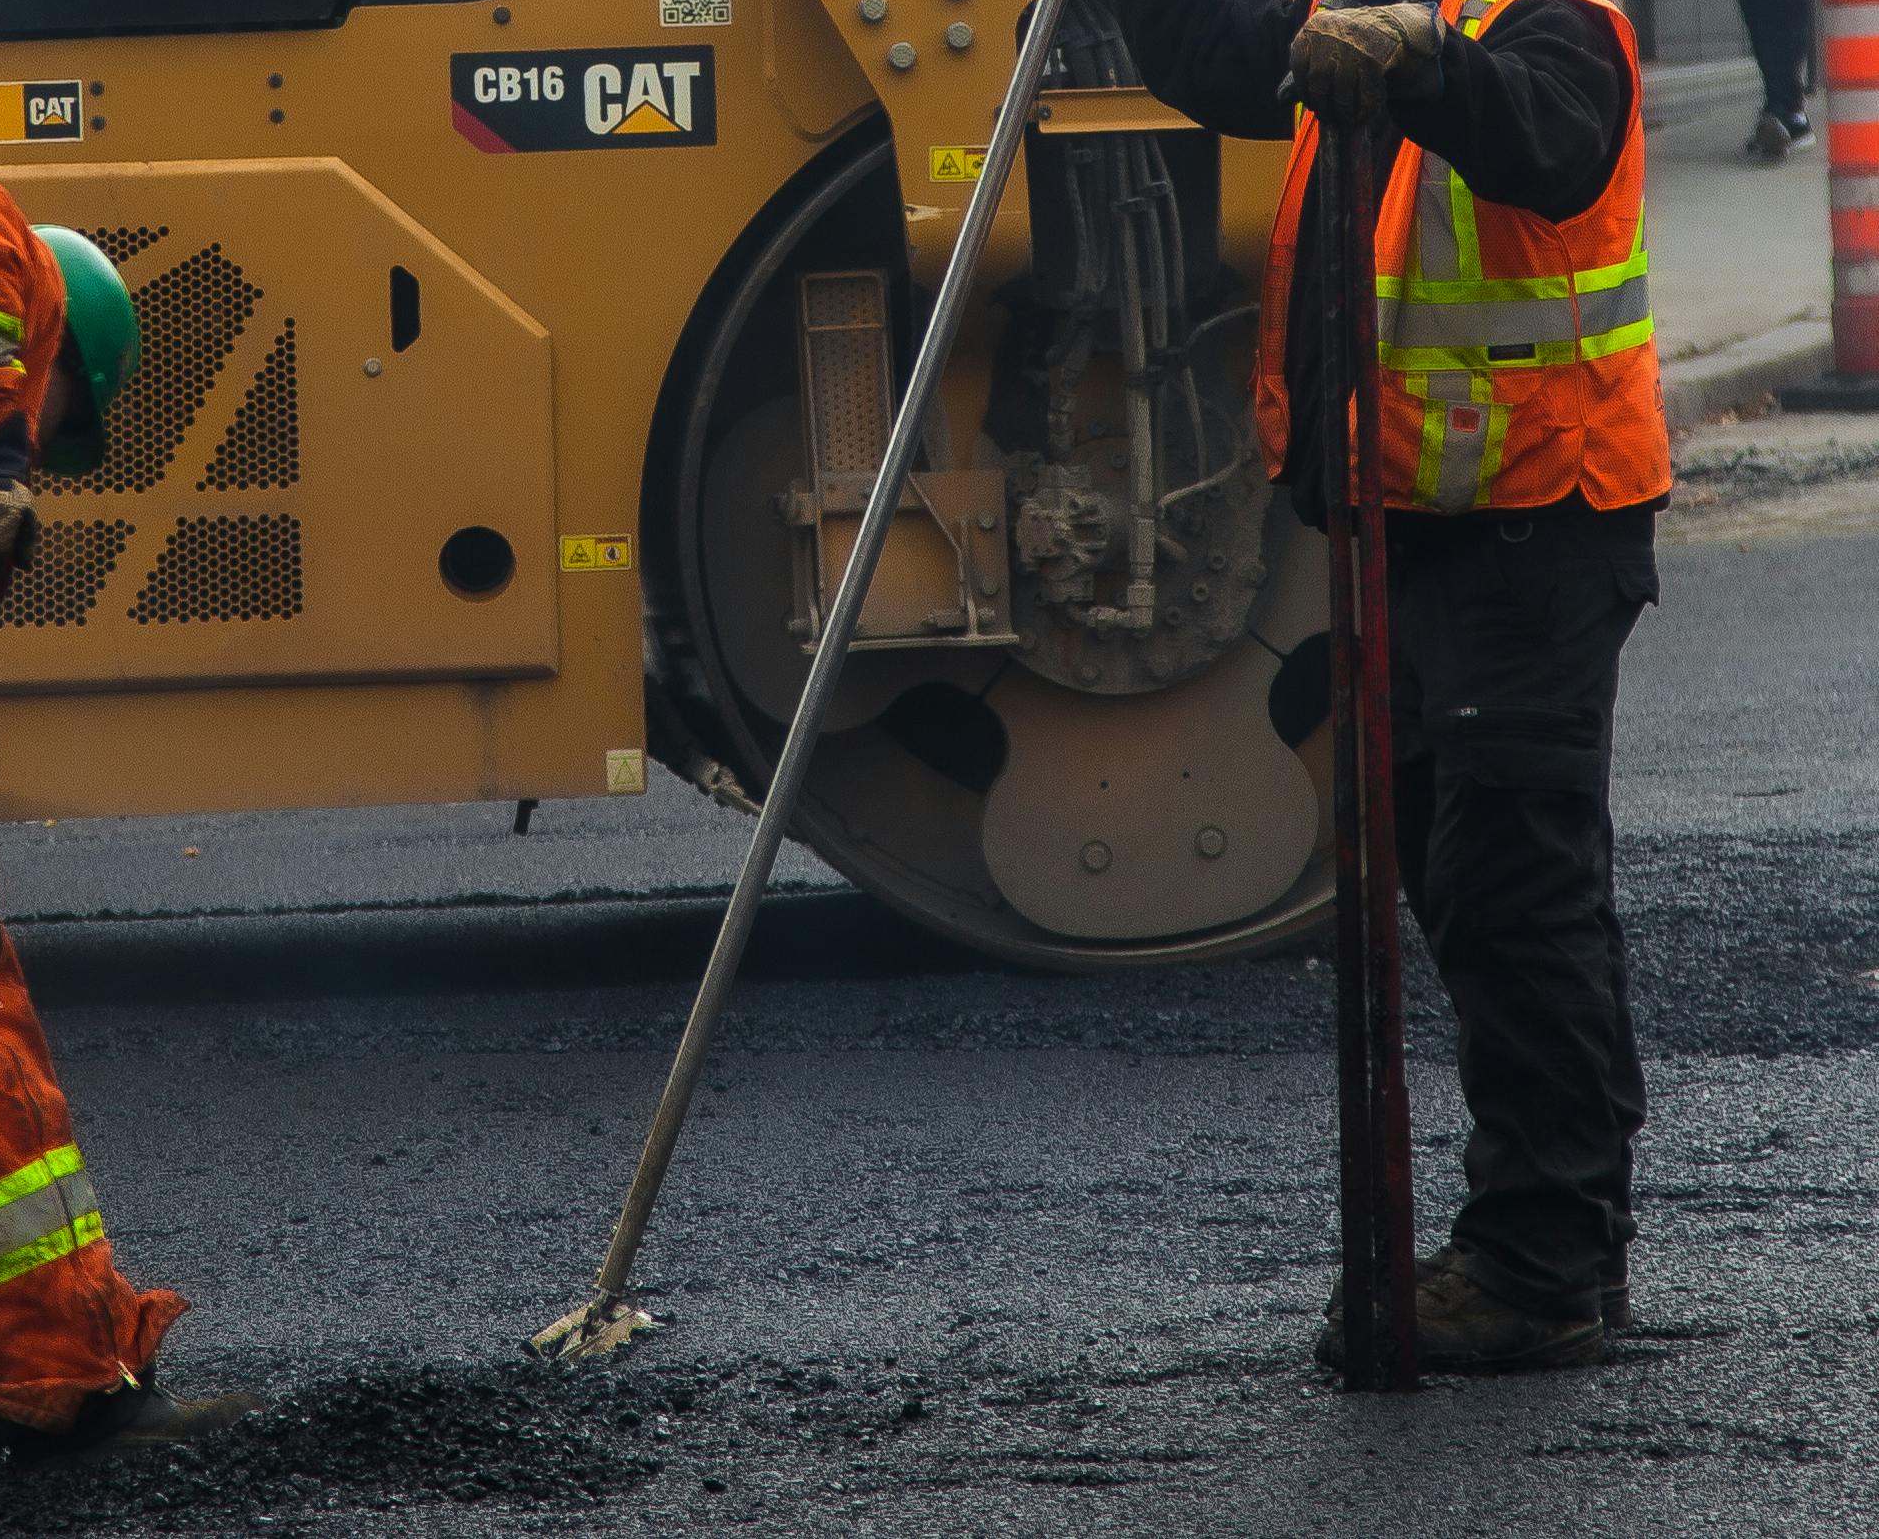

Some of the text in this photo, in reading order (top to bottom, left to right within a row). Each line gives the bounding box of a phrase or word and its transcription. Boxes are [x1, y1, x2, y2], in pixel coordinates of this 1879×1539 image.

[28, 96, 75, 126] CAT
[473, 61, 701, 135] CB16 CAT
